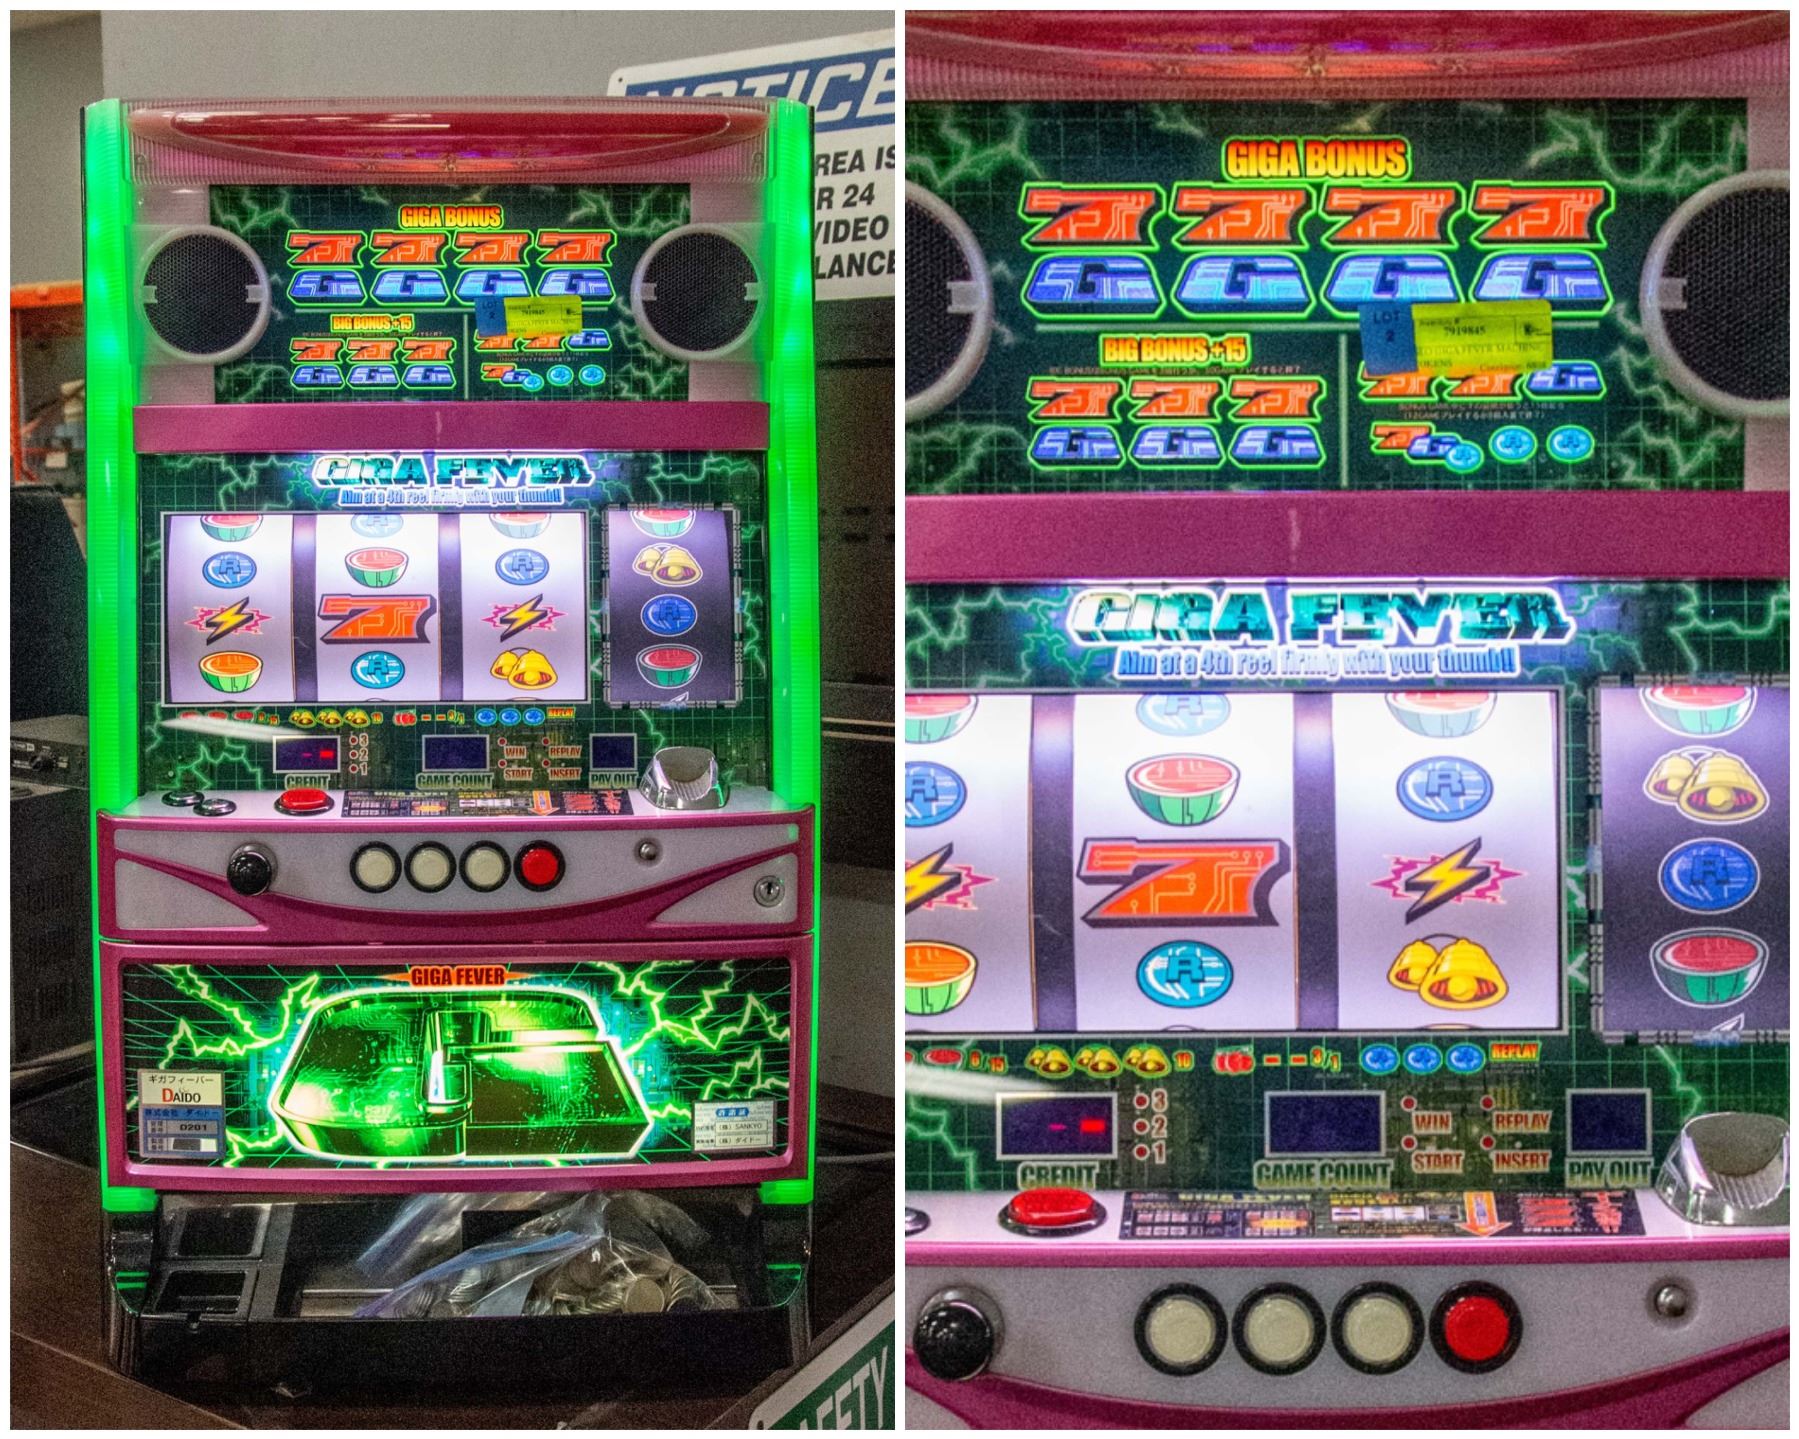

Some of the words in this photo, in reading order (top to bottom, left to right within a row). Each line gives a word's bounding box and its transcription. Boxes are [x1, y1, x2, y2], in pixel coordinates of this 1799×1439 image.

[645, 56, 895, 122] TICE
[1226, 140, 1299, 177] GIGA
[1305, 139, 1406, 177] BONUS
[842, 182, 875, 208] 24
[401, 206, 442, 227] GIGA
[445, 206, 501, 227] BONUS
[333, 316, 352, 330] BIG
[354, 316, 391, 330] BONUS
[1104, 337, 1138, 361] BIG
[1141, 337, 1208, 361] BONUS
[1210, 337, 1247, 361] +15
[315, 457, 427, 486] GIGA
[436, 457, 593, 486] FEVER
[1072, 590, 1276, 643] GIGA
[1289, 590, 1574, 643] FEVER
[1118, 650, 1157, 675] Aim
[1160, 651, 1181, 675] at
[1184, 653, 1198, 675] a
[1201, 650, 1232, 675] 4th
[1237, 651, 1277, 675] reel
[1281, 648, 1340, 677] firmly
[1344, 648, 1387, 674] with
[1389, 651, 1436, 677] your
[547, 707, 576, 718] REPLAY
[359, 733, 369, 747] 3
[359, 748, 369, 761] 2
[505, 747, 526, 757] WIN
[550, 746, 581, 757] REPLAY
[360, 762, 368, 775] 1
[505, 769, 532, 779] START
[550, 768, 580, 779] INSERT
[285, 774, 330, 789] CREDIT
[416, 774, 451, 789] GAME
[453, 774, 493, 788] COUNT
[590, 773, 612, 788] PAY
[614, 773, 637, 787] OUT
[1077, 837, 1291, 929] 7
[411, 967, 453, 986] GIGA
[456, 967, 505, 986] FEVER
[1490, 1042, 1539, 1060] REPLAY
[1174, 1051, 1194, 1070] 10
[149, 1074, 214, 1084] ギガフィーバー
[162, 1087, 201, 1103] DAIDO
[1152, 1088, 1168, 1112] 3
[1152, 1114, 1168, 1138] 2
[1415, 1114, 1450, 1131] WIN
[1495, 1113, 1551, 1131] REPLAY
[1153, 1141, 1166, 1164] 1
[1495, 1152, 1550, 1171] INSERT
[1414, 1153, 1463, 1171] START
[1019, 1162, 1099, 1189] CREDIT
[1254, 1162, 1318, 1188] GAME
[1320, 1162, 1393, 1187] COUNT
[1568, 1160, 1610, 1187] PAY
[1612, 1160, 1651, 1186] OUT
